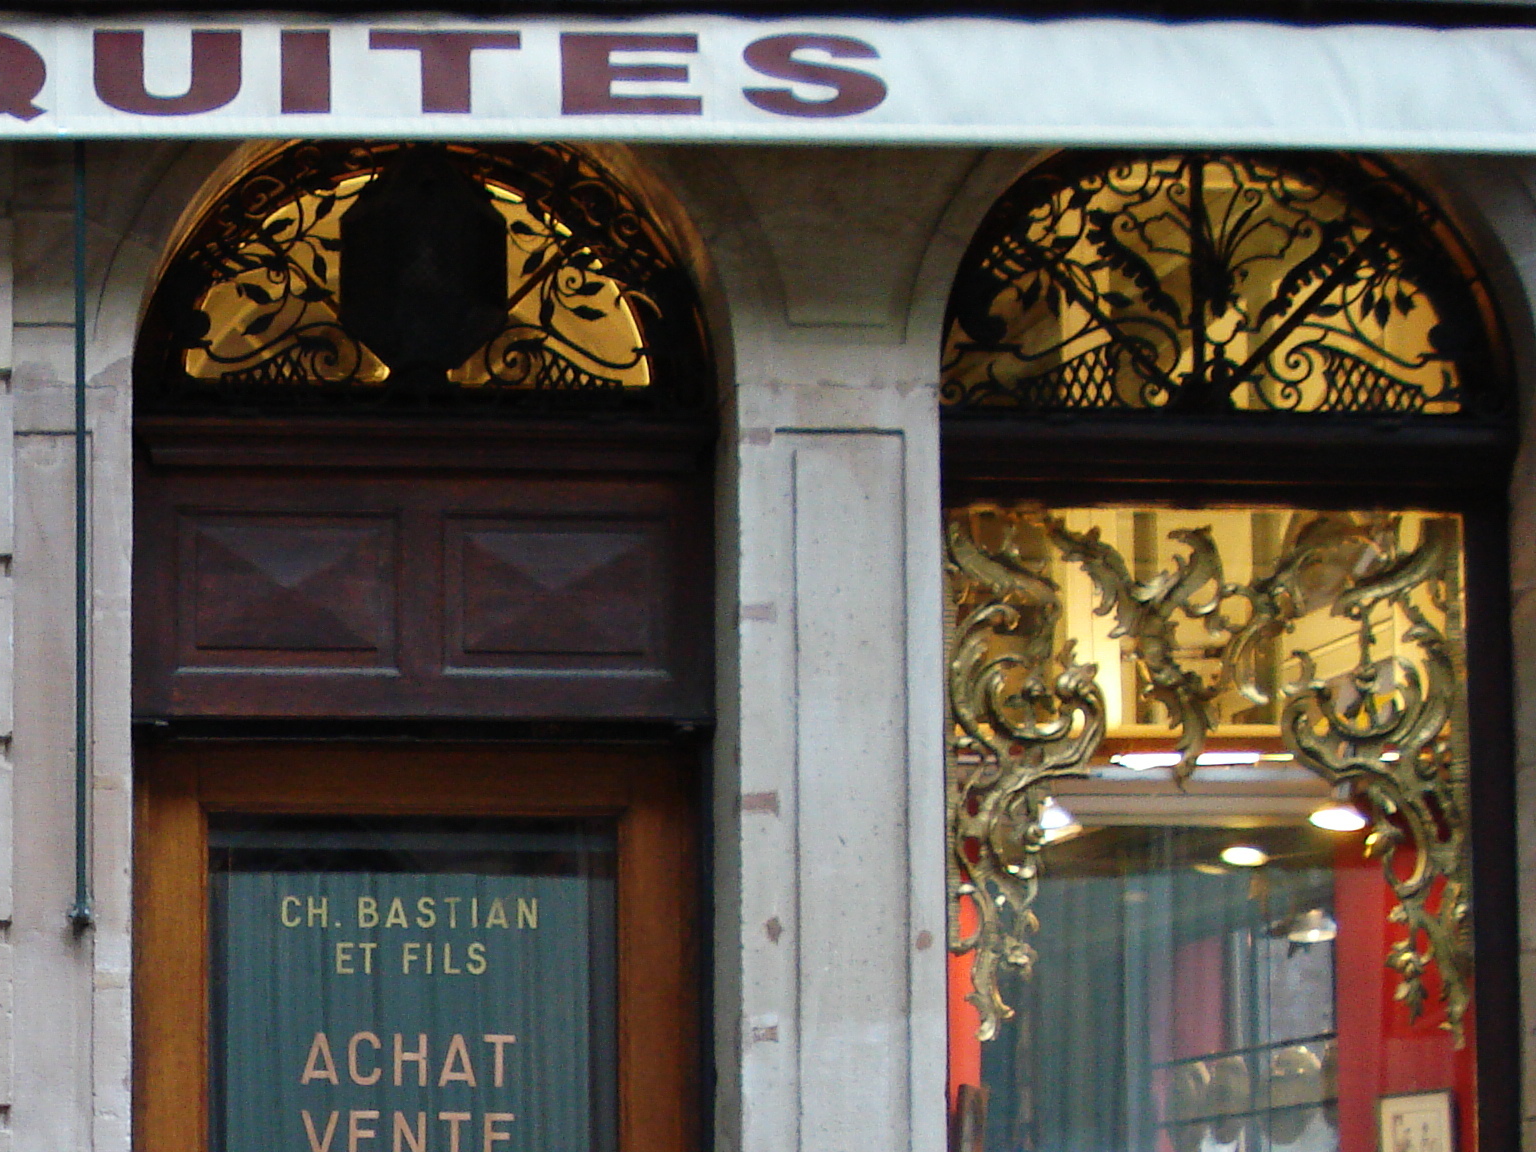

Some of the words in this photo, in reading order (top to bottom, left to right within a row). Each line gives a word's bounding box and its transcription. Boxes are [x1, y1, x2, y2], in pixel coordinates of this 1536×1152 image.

[280, 896, 342, 928] CH.
[357, 896, 539, 930] BASTIAN
[335, 942, 378, 975] ET
[402, 942, 488, 975] FILS
[300, 1031, 517, 1088] ACHAT
